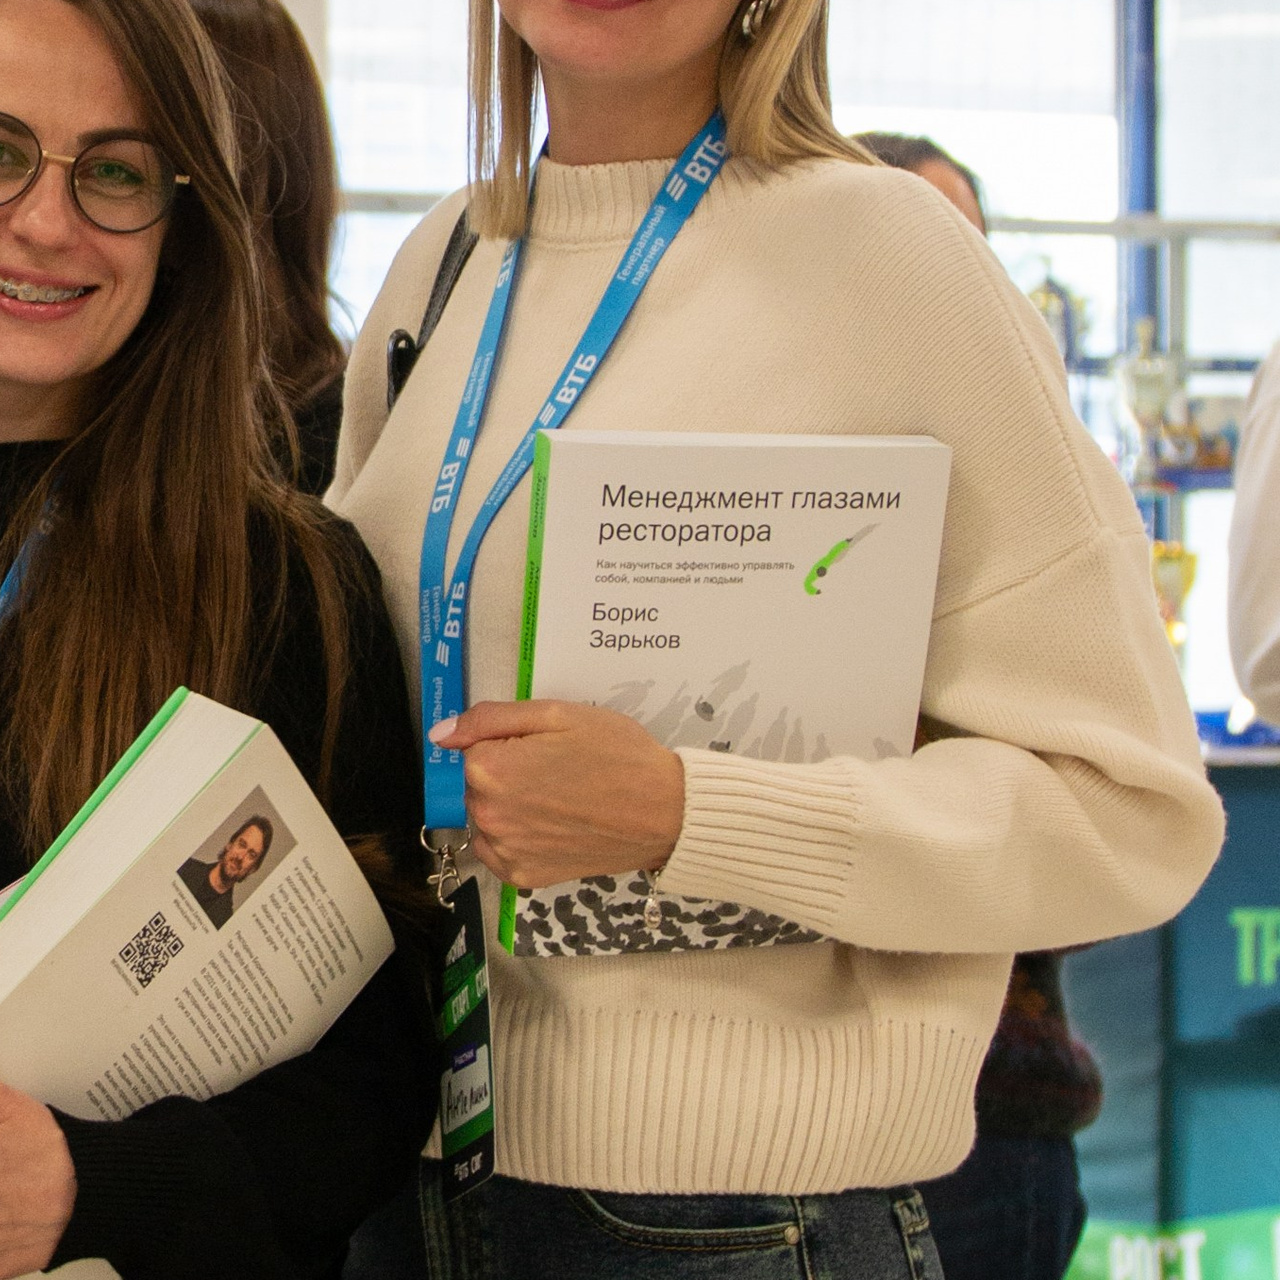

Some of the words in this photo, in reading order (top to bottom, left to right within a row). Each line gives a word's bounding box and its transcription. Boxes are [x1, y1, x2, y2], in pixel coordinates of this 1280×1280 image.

[684, 134, 727, 184] ВТБ
[617, 204, 666, 281] Генеральный
[632, 237, 665, 285] партнер
[556, 352, 597, 405] ВТБ
[432, 461, 460, 514] ВТБ
[601, 484, 783, 512] Менеджмент
[791, 491, 901, 509] глазами
[598, 522, 772, 546] ресторатора
[595, 573, 630, 585] собой,
[633, 575, 692, 586] компанией
[703, 578, 744, 586] людьми
[596, 559, 617, 569] Как
[620, 561, 673, 572] научиться
[675, 561, 740, 573] эффективно
[742, 562, 795, 573] управлять
[423, 589, 432, 644] партнер
[444, 581, 465, 639] ВТБ
[592, 603, 659, 624] Борис
[589, 630, 680, 651] Зарьков
[1230, 907, 1280, 987] ТР
